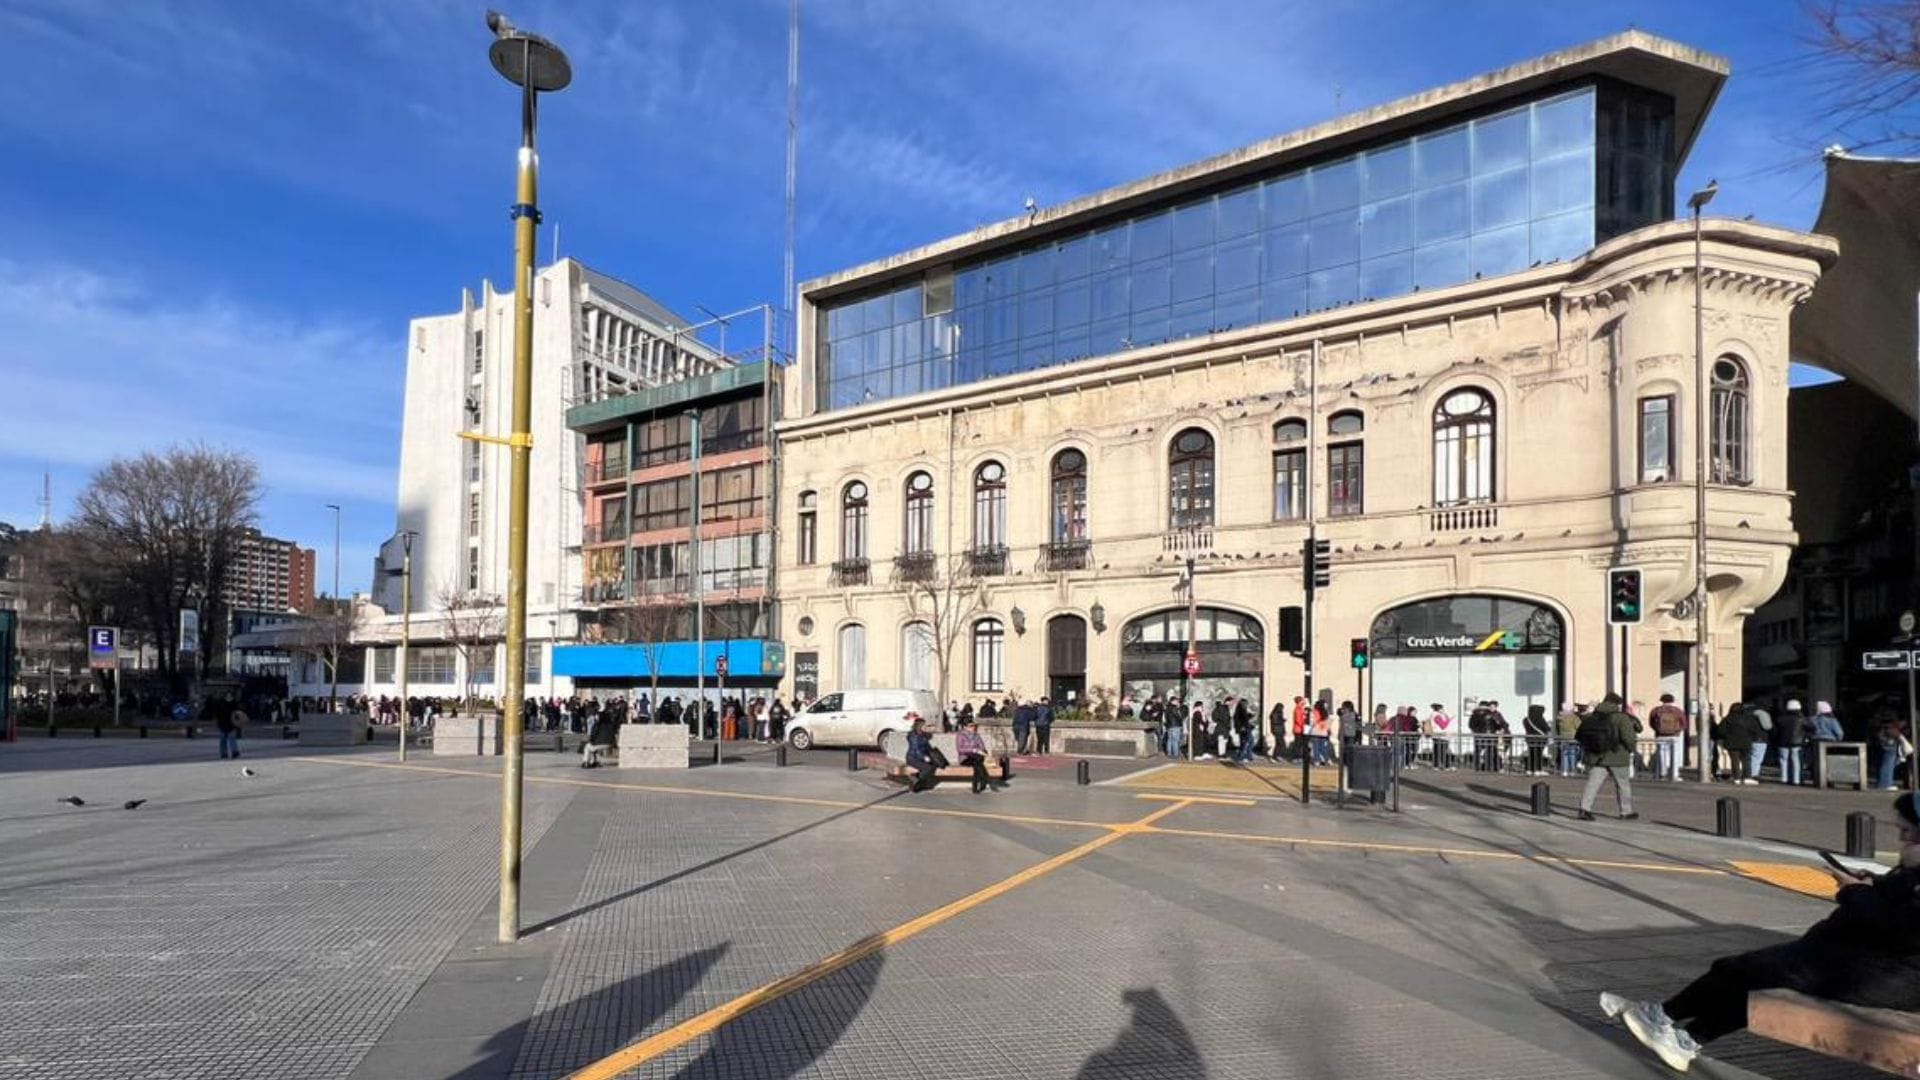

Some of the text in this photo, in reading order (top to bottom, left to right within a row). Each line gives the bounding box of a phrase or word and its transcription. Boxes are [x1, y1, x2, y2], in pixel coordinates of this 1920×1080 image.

[97, 631, 109, 645] E
[1407, 635, 1474, 647] Cruz Verde
